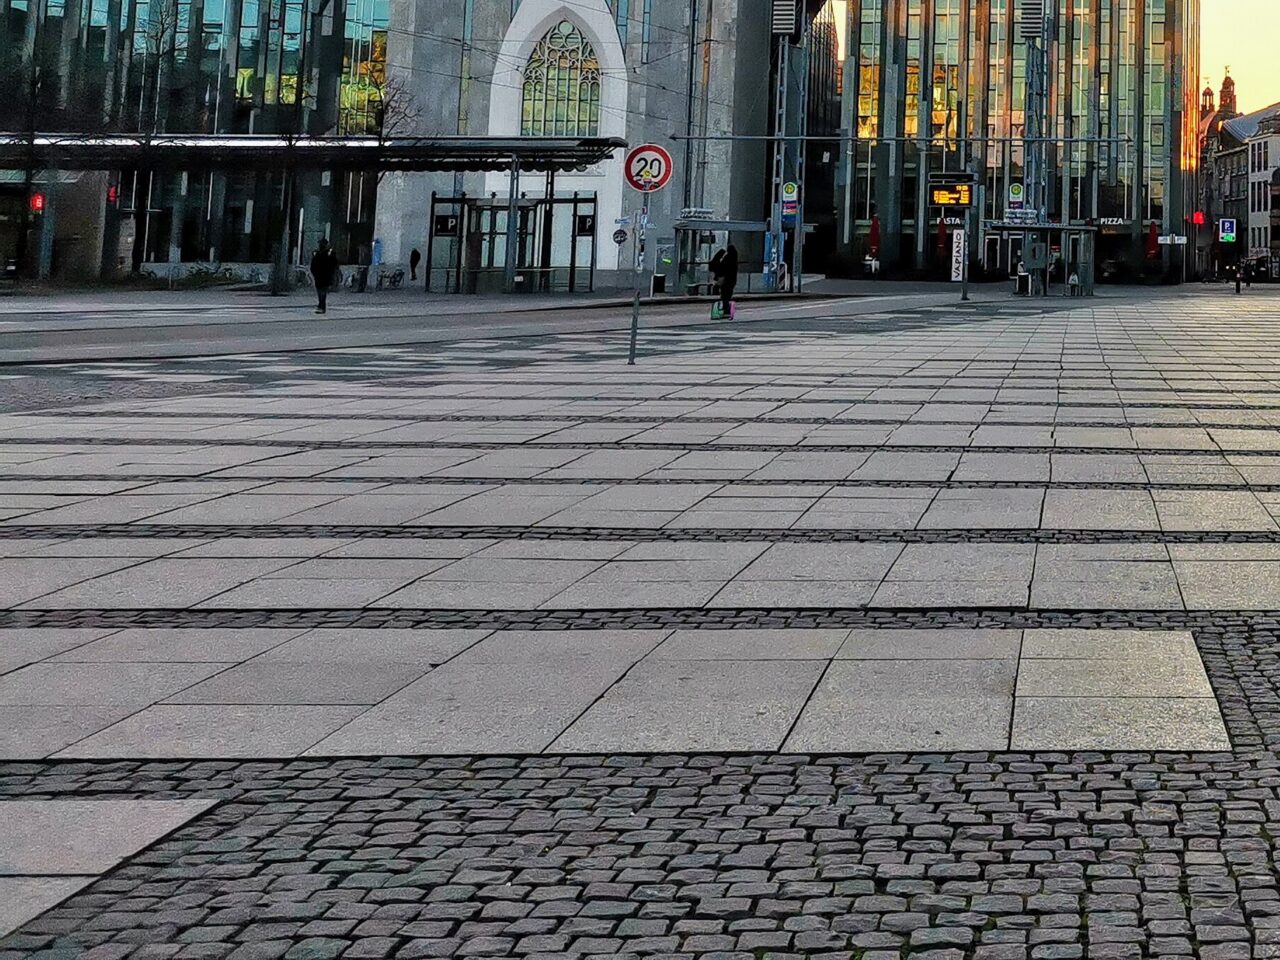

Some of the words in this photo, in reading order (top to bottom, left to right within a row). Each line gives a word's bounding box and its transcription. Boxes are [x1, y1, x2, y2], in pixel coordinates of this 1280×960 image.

[635, 157, 662, 179] 20
[448, 218, 456, 230] P
[586, 218, 592, 230] P
[1100, 217, 1124, 225] PIZZA
[953, 232, 962, 279] VAPIANO
